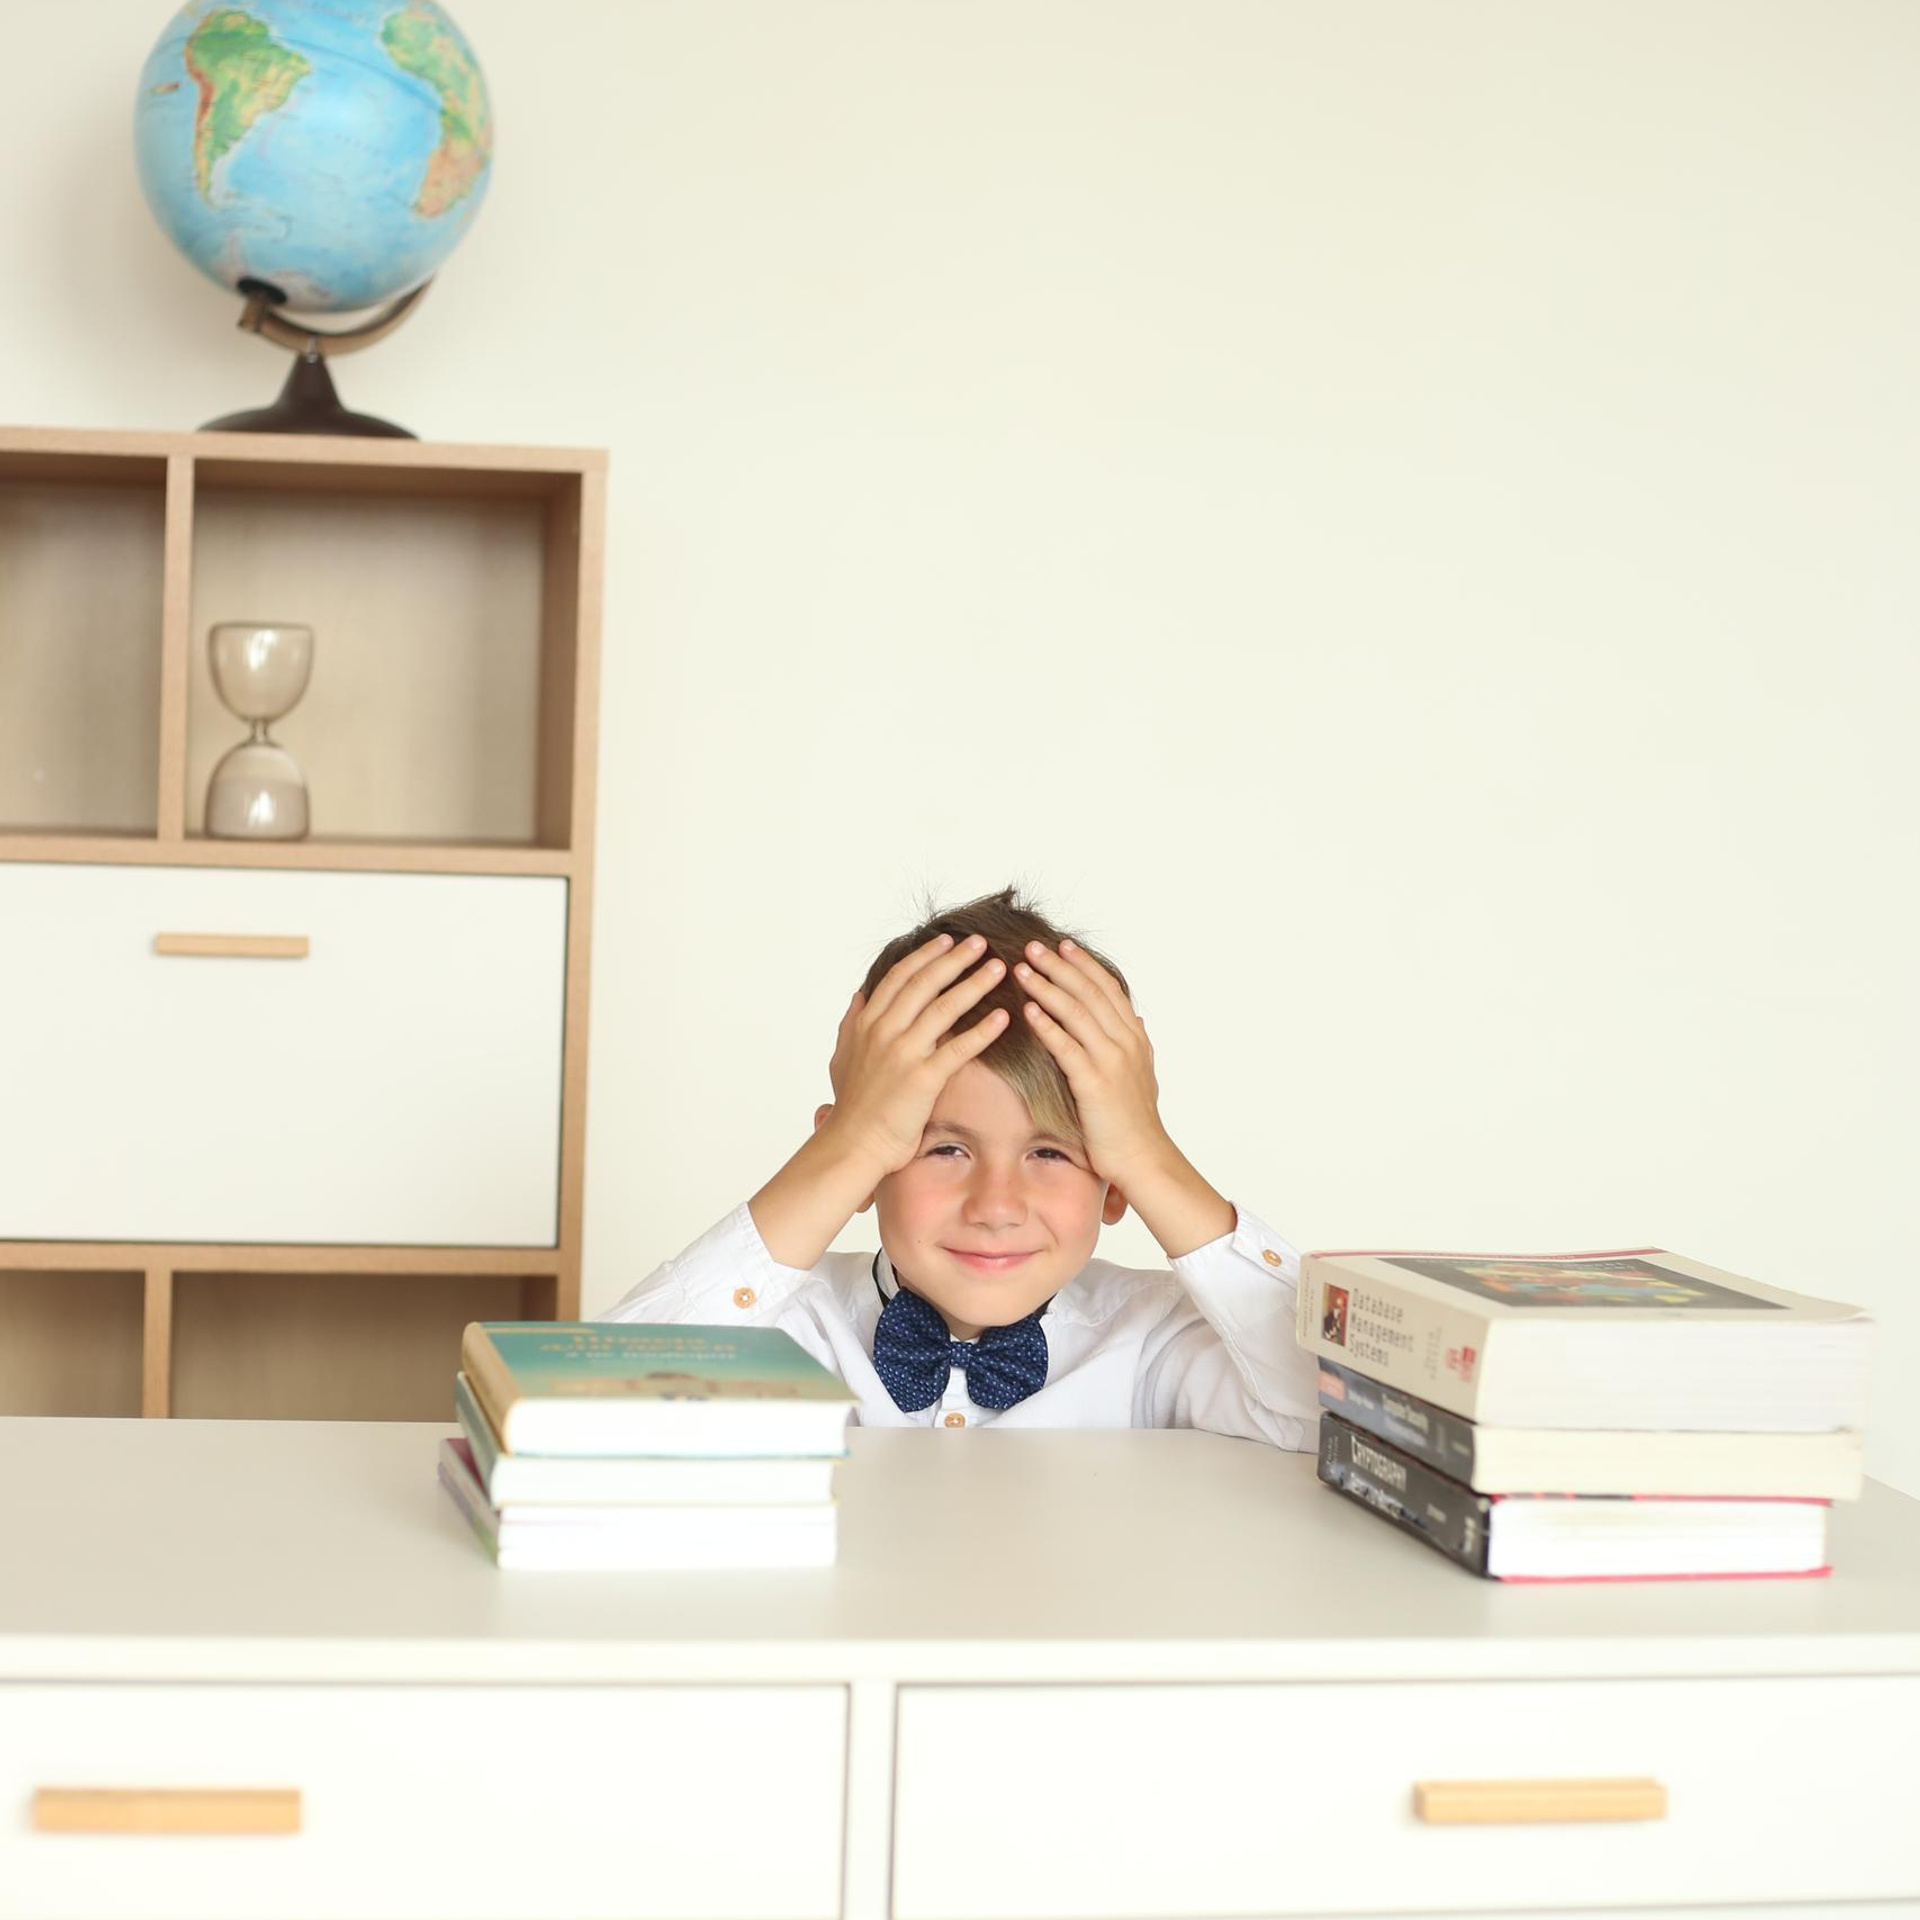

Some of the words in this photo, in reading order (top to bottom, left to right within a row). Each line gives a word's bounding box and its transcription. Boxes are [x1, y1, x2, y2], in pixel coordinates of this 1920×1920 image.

[1352, 1287, 1403, 1324] Database
[1350, 1333, 1390, 1367] Systems
[1351, 1312, 1414, 1353] Management
